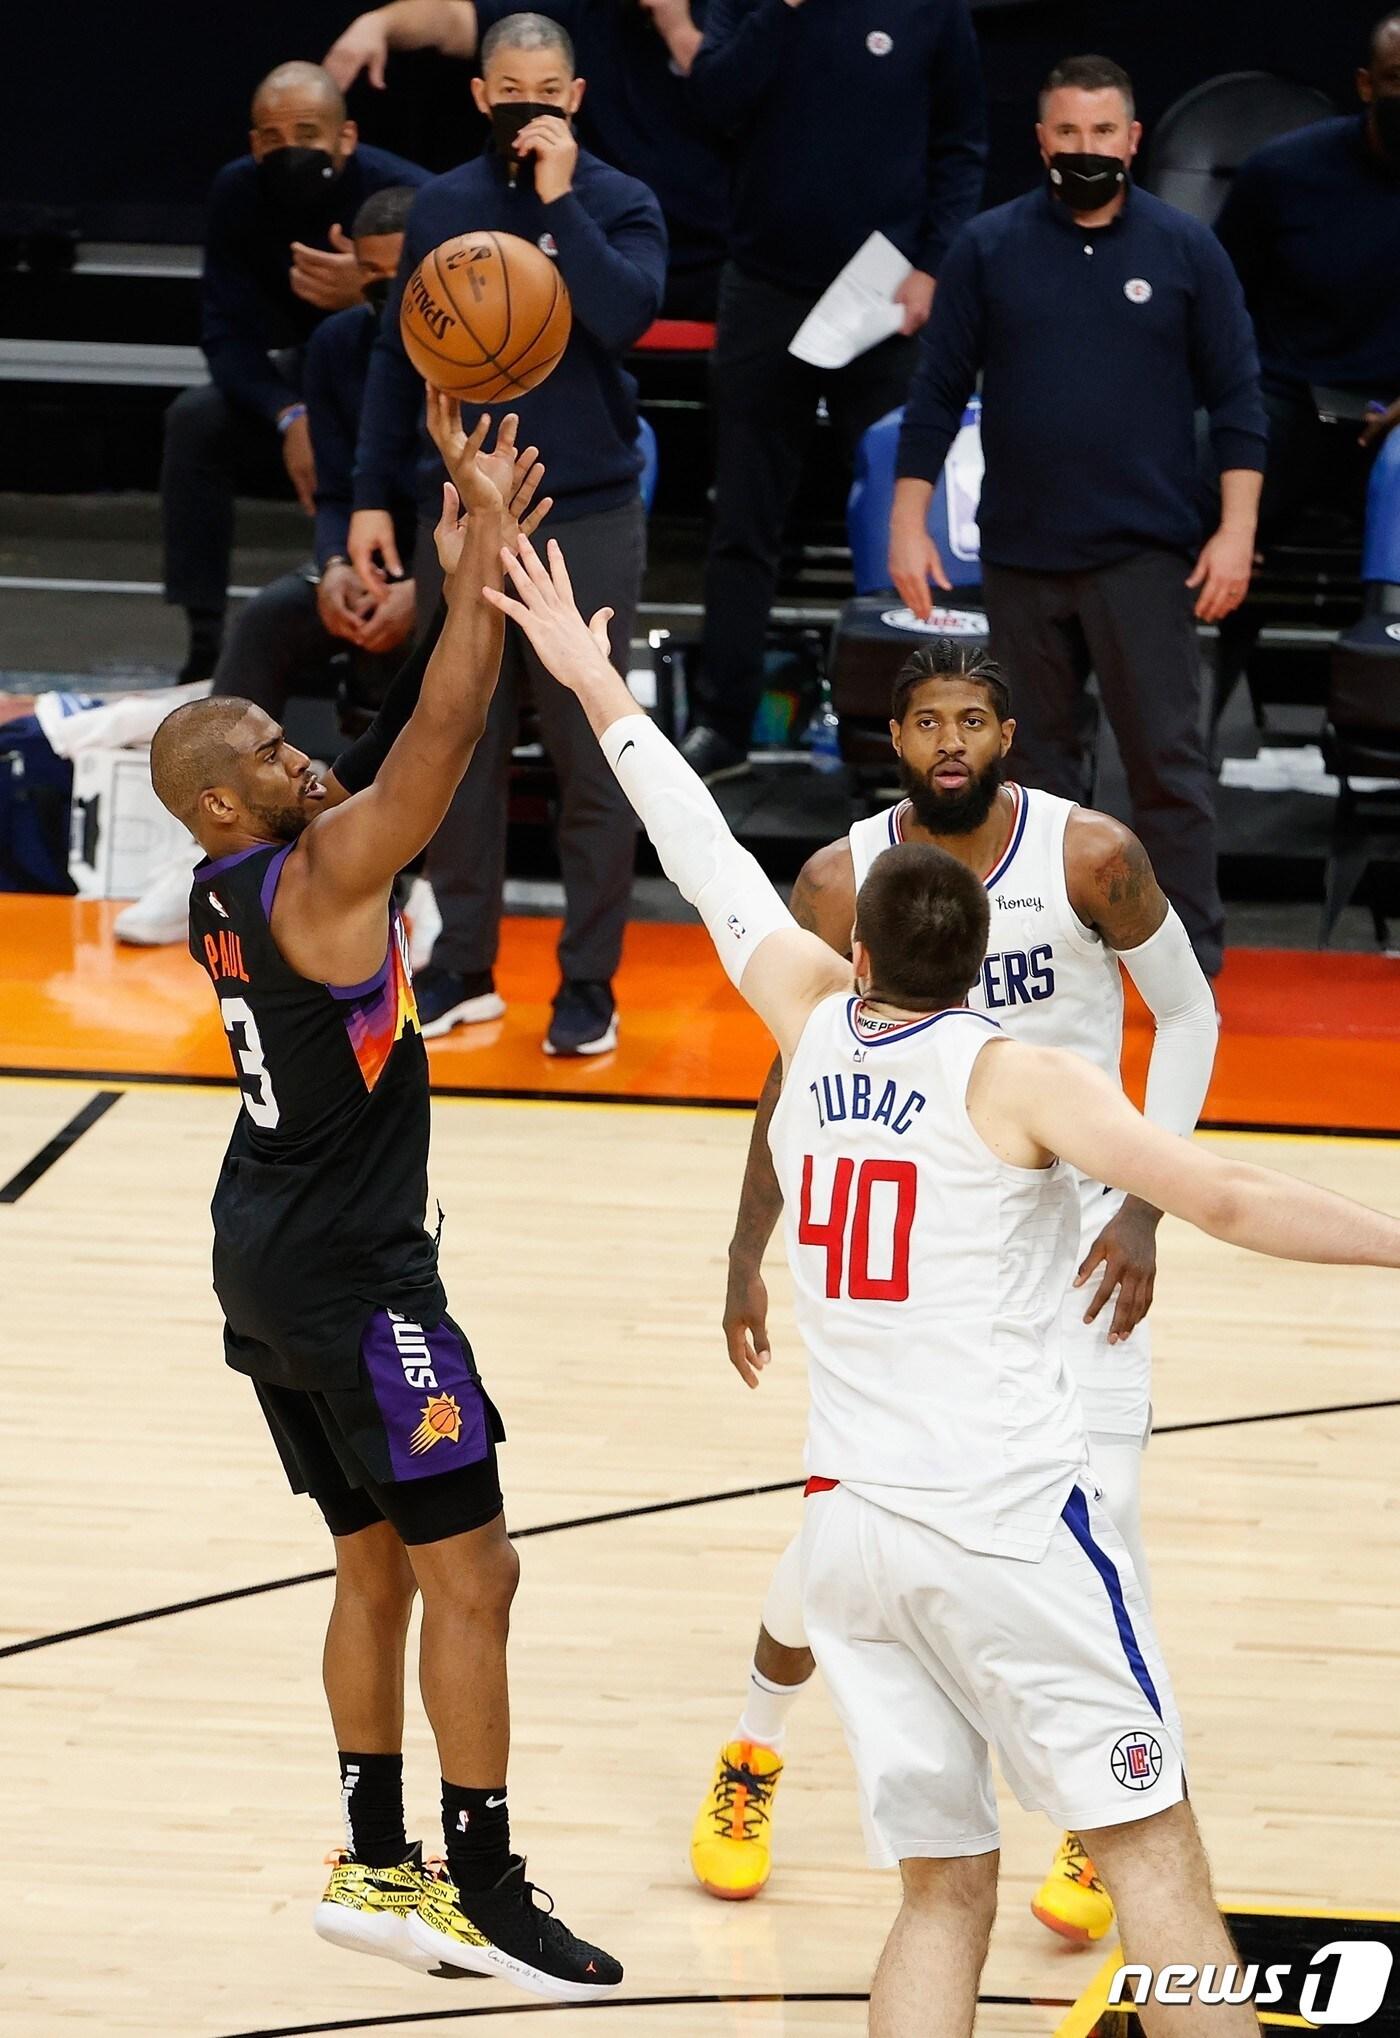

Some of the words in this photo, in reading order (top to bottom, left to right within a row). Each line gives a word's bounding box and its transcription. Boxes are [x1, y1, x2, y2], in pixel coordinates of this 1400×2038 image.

[995, 895, 1045, 912] honey
[204, 930, 250, 983] PAUL
[975, 943, 1055, 1009] ERS
[221, 997, 280, 1129] 3
[810, 1073, 926, 1135] ZUBAC
[799, 1154, 917, 1302] 40
[422, 1907, 449, 1934] CROSS
